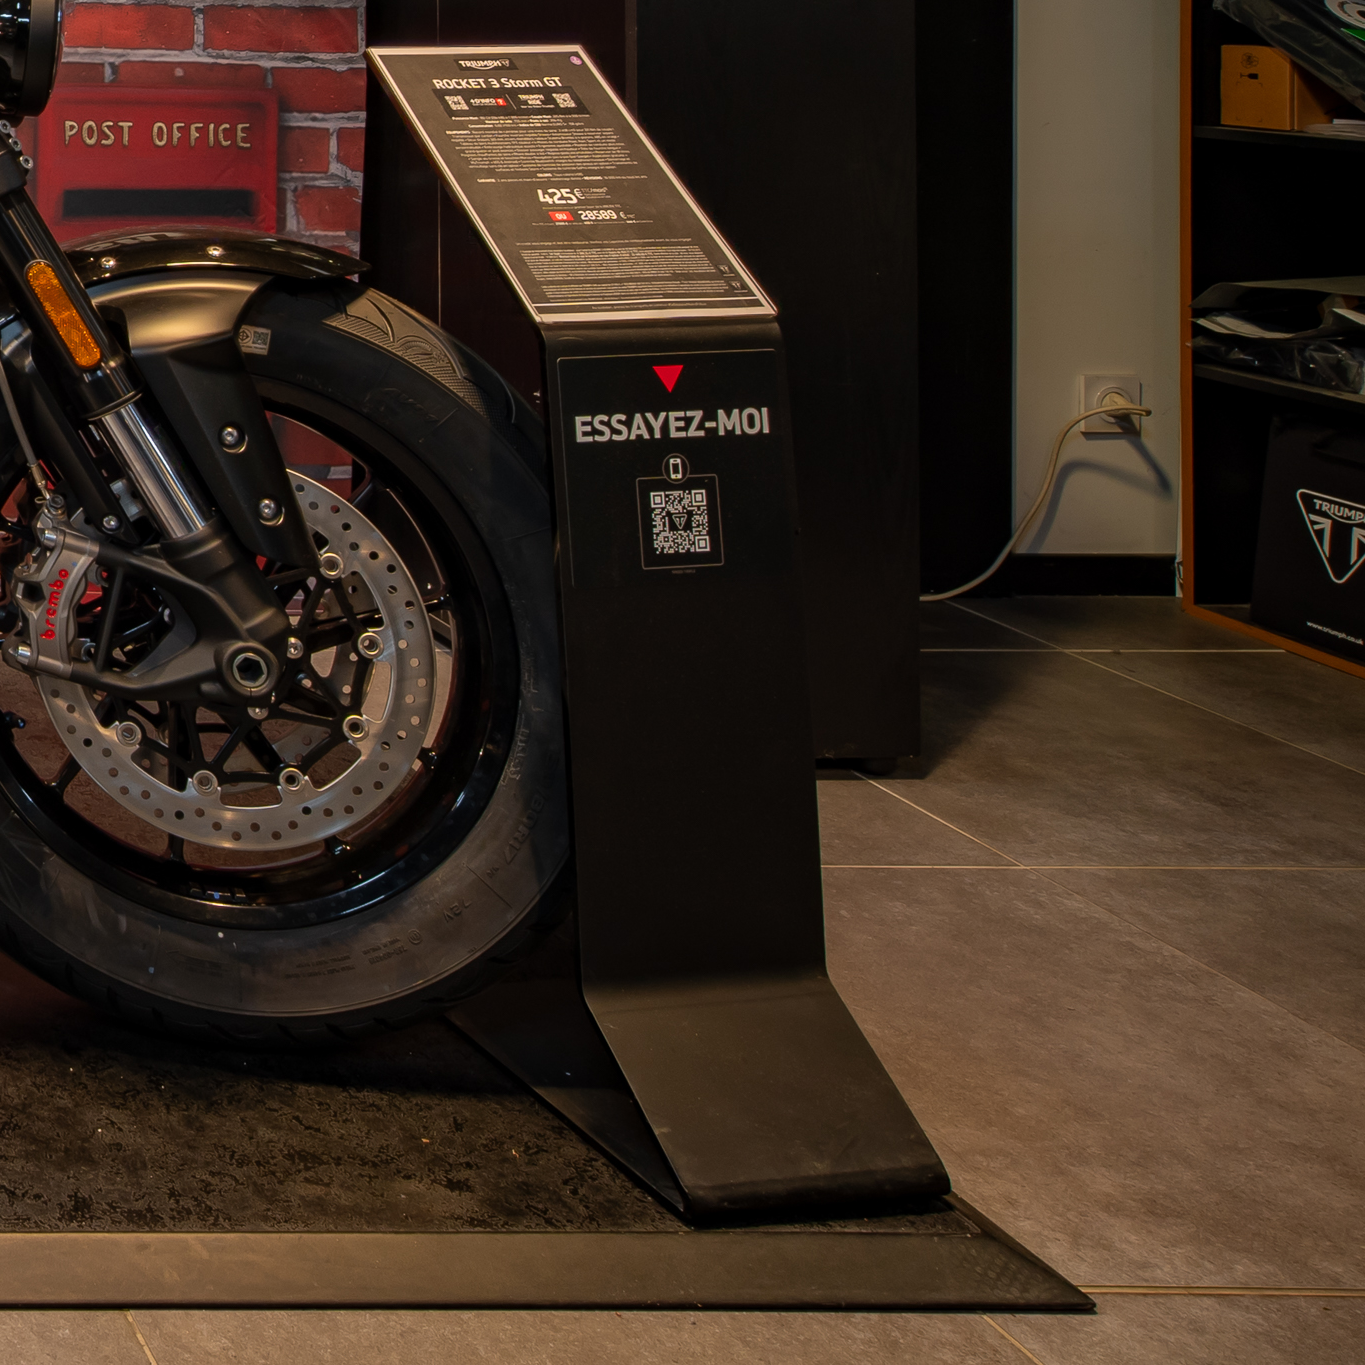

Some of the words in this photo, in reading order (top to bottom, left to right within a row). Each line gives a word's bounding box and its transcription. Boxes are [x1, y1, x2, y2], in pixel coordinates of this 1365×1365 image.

[458, 60, 502, 69] TRIUMPH
[432, 78, 486, 89] ROCKET
[488, 78, 500, 88] 3
[501, 77, 543, 88] Storm
[543, 76, 562, 87] GT
[63, 120, 133, 147] POST
[152, 120, 252, 148] OFFICE
[578, 210, 617, 220] 28589
[574, 407, 770, 443] ESSAYEZ-MOI
[1313, 498, 1365, 523] TRIUMP
[40, 568, 69, 640] brembo
[1306, 621, 1364, 645] www.triumph.co.uk
